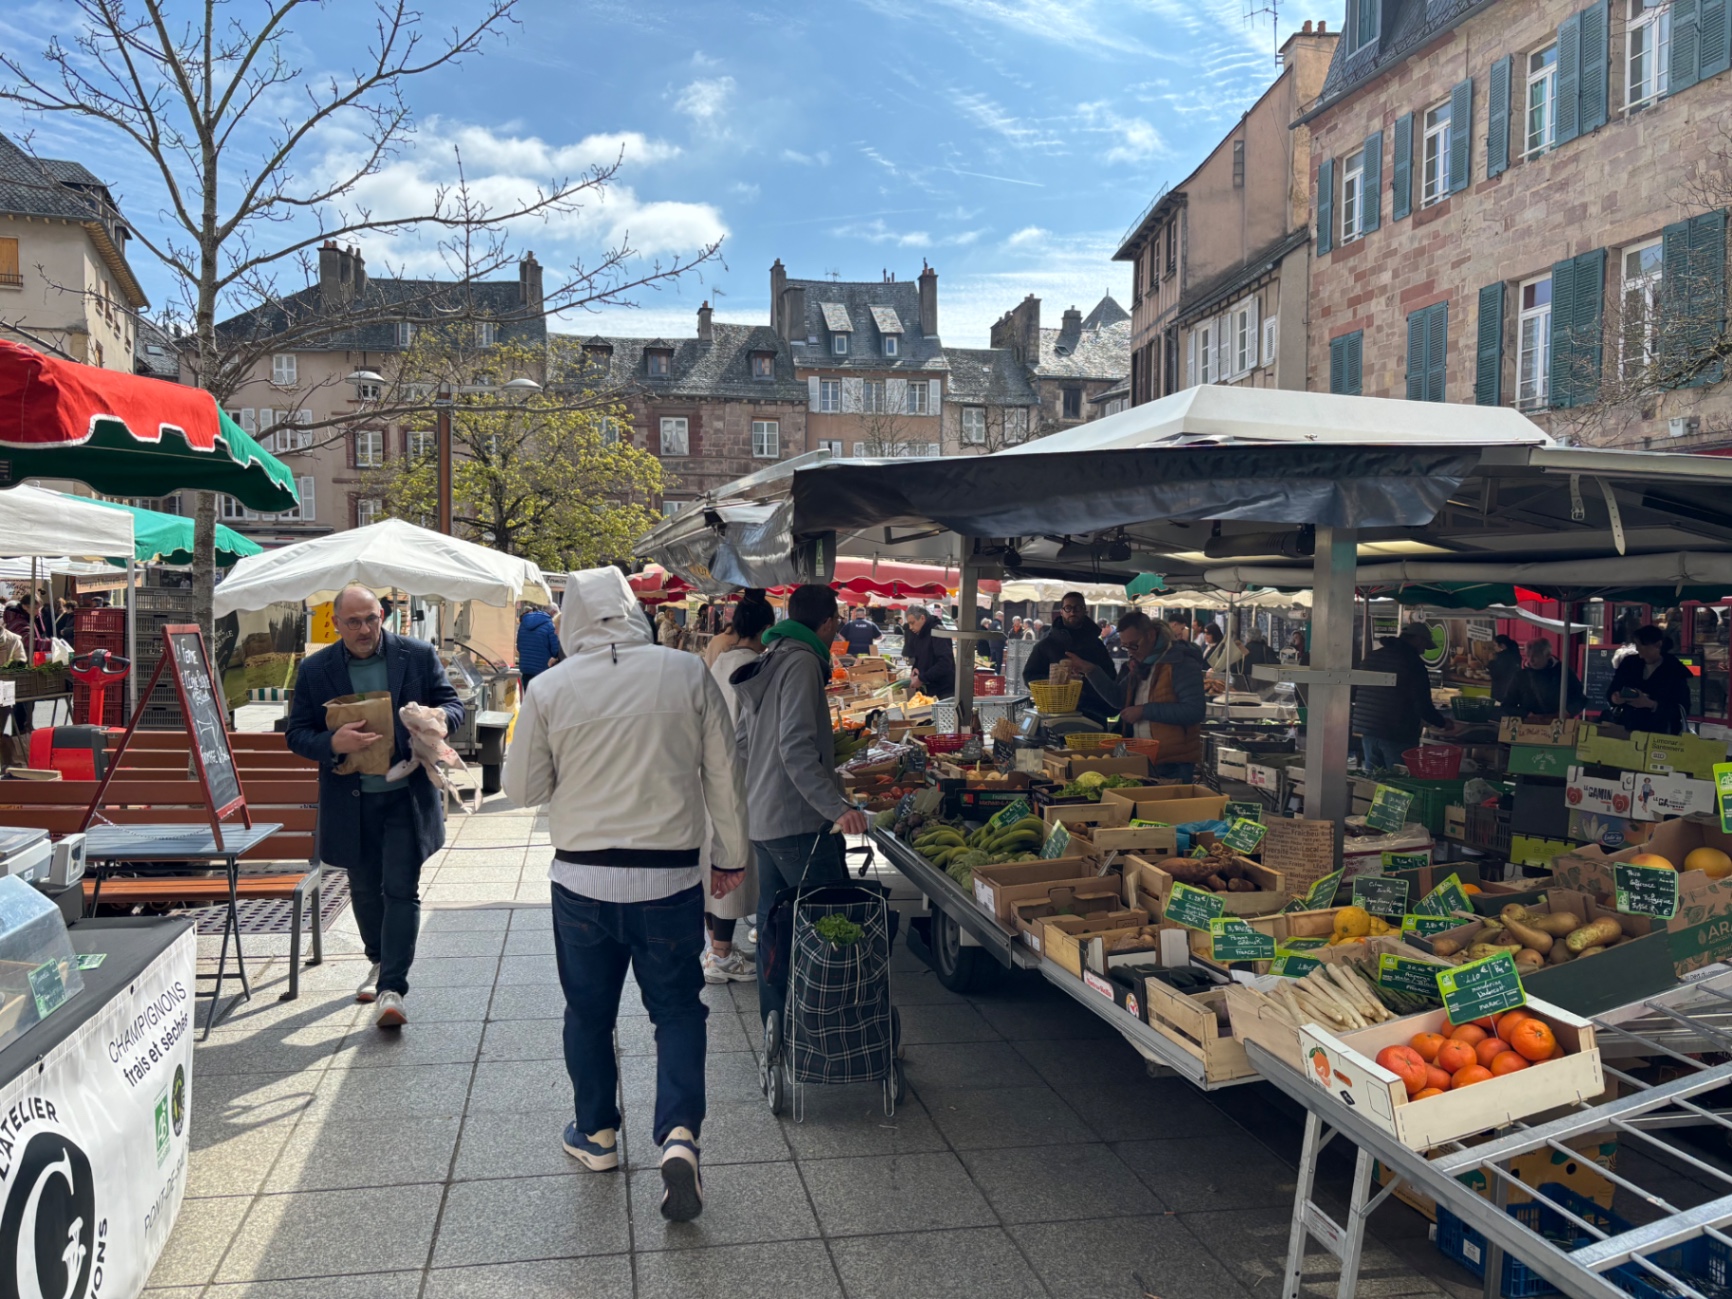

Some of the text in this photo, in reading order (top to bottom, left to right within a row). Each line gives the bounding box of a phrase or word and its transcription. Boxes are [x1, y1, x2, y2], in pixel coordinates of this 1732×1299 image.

[1588, 786, 1612, 800] GAMIN
[1708, 921, 1732, 940] AR
[108, 982, 186, 1063] CHAMPIGNONS
[123, 1056, 150, 1087] frais
[148, 1041, 163, 1063] et
[161, 1010, 188, 1051] séchés
